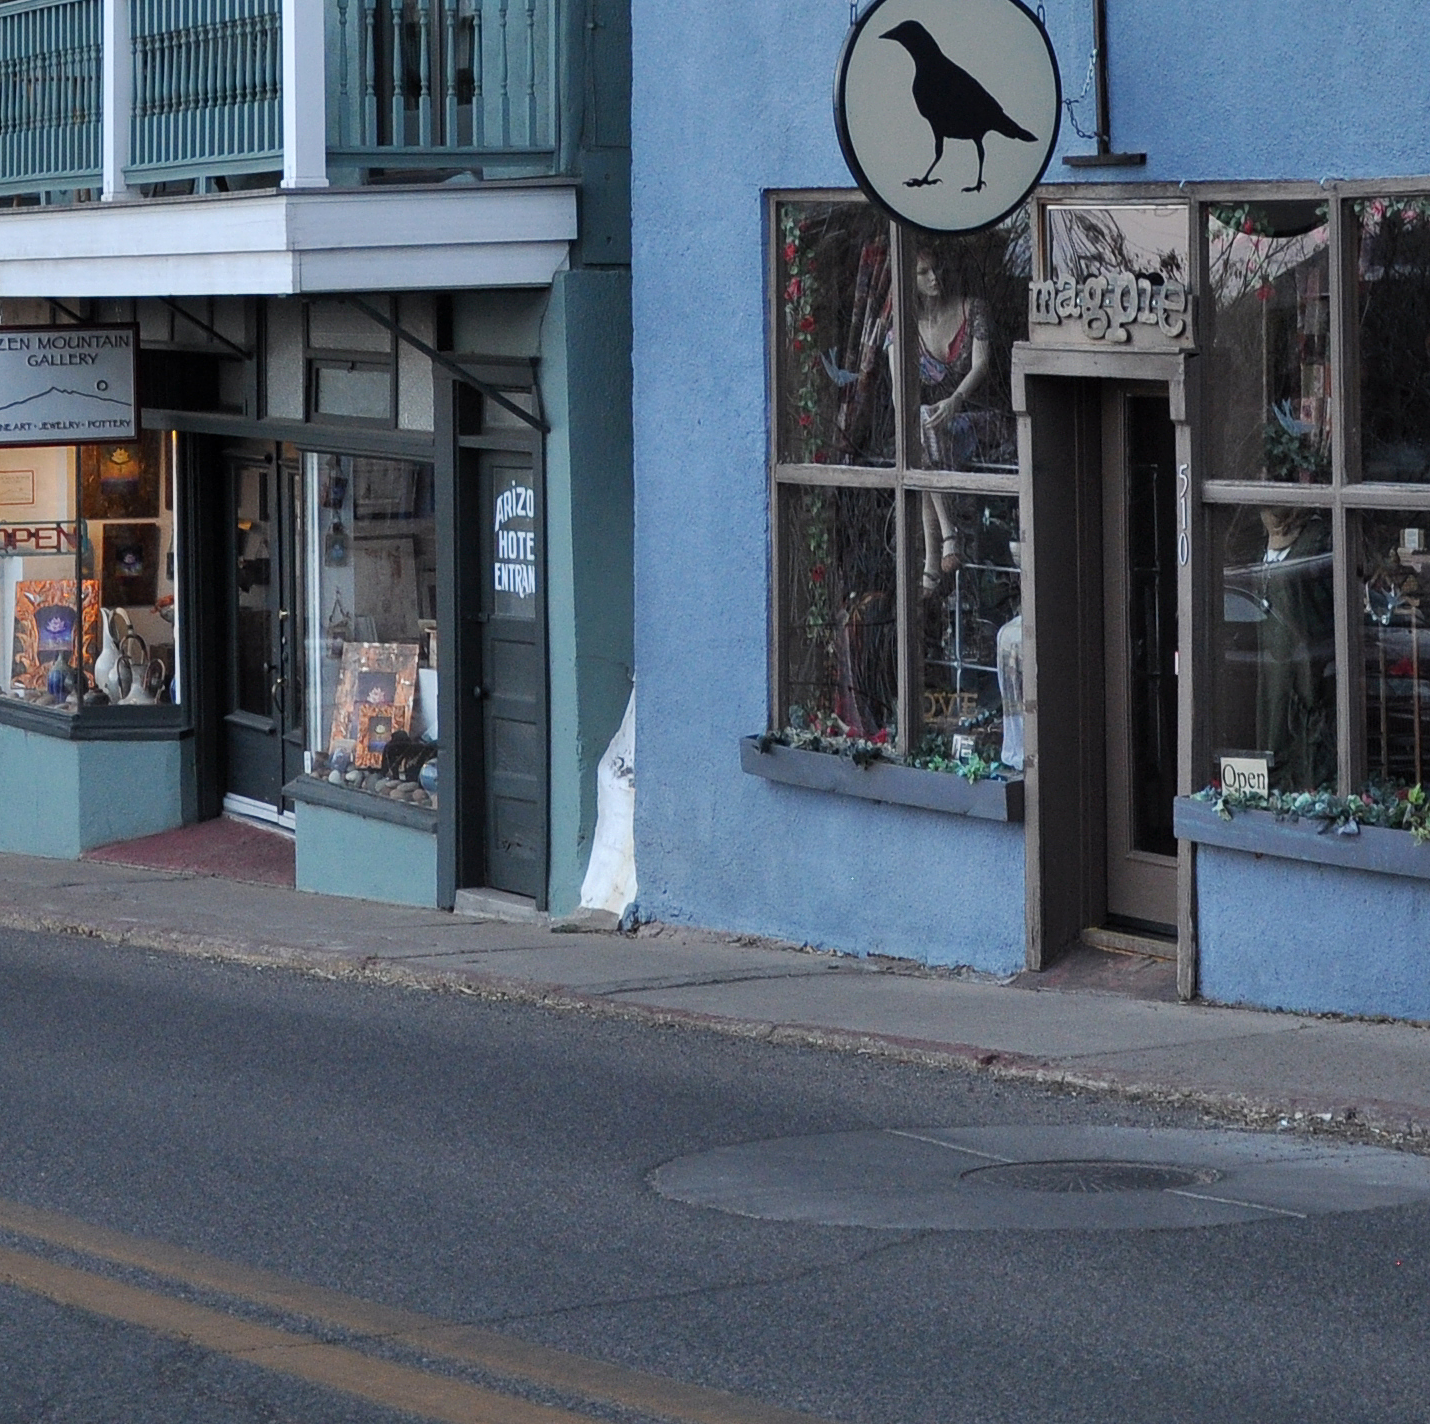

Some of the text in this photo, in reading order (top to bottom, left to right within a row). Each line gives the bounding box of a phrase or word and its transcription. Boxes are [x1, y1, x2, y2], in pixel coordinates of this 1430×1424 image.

[1029, 270, 1185, 343] magpie
[37, 335, 129, 350] MOUNTAIN
[27, 353, 98, 367] GALLERY
[12, 422, 31, 431] ART
[38, 420, 81, 431] JEWELRY
[87, 419, 132, 429] POTTERY
[1179, 463, 1190, 567] 510
[498, 530, 535, 561] HOTE
[494, 562, 536, 599] ENTRAN
[1222, 763, 1266, 797] Open
